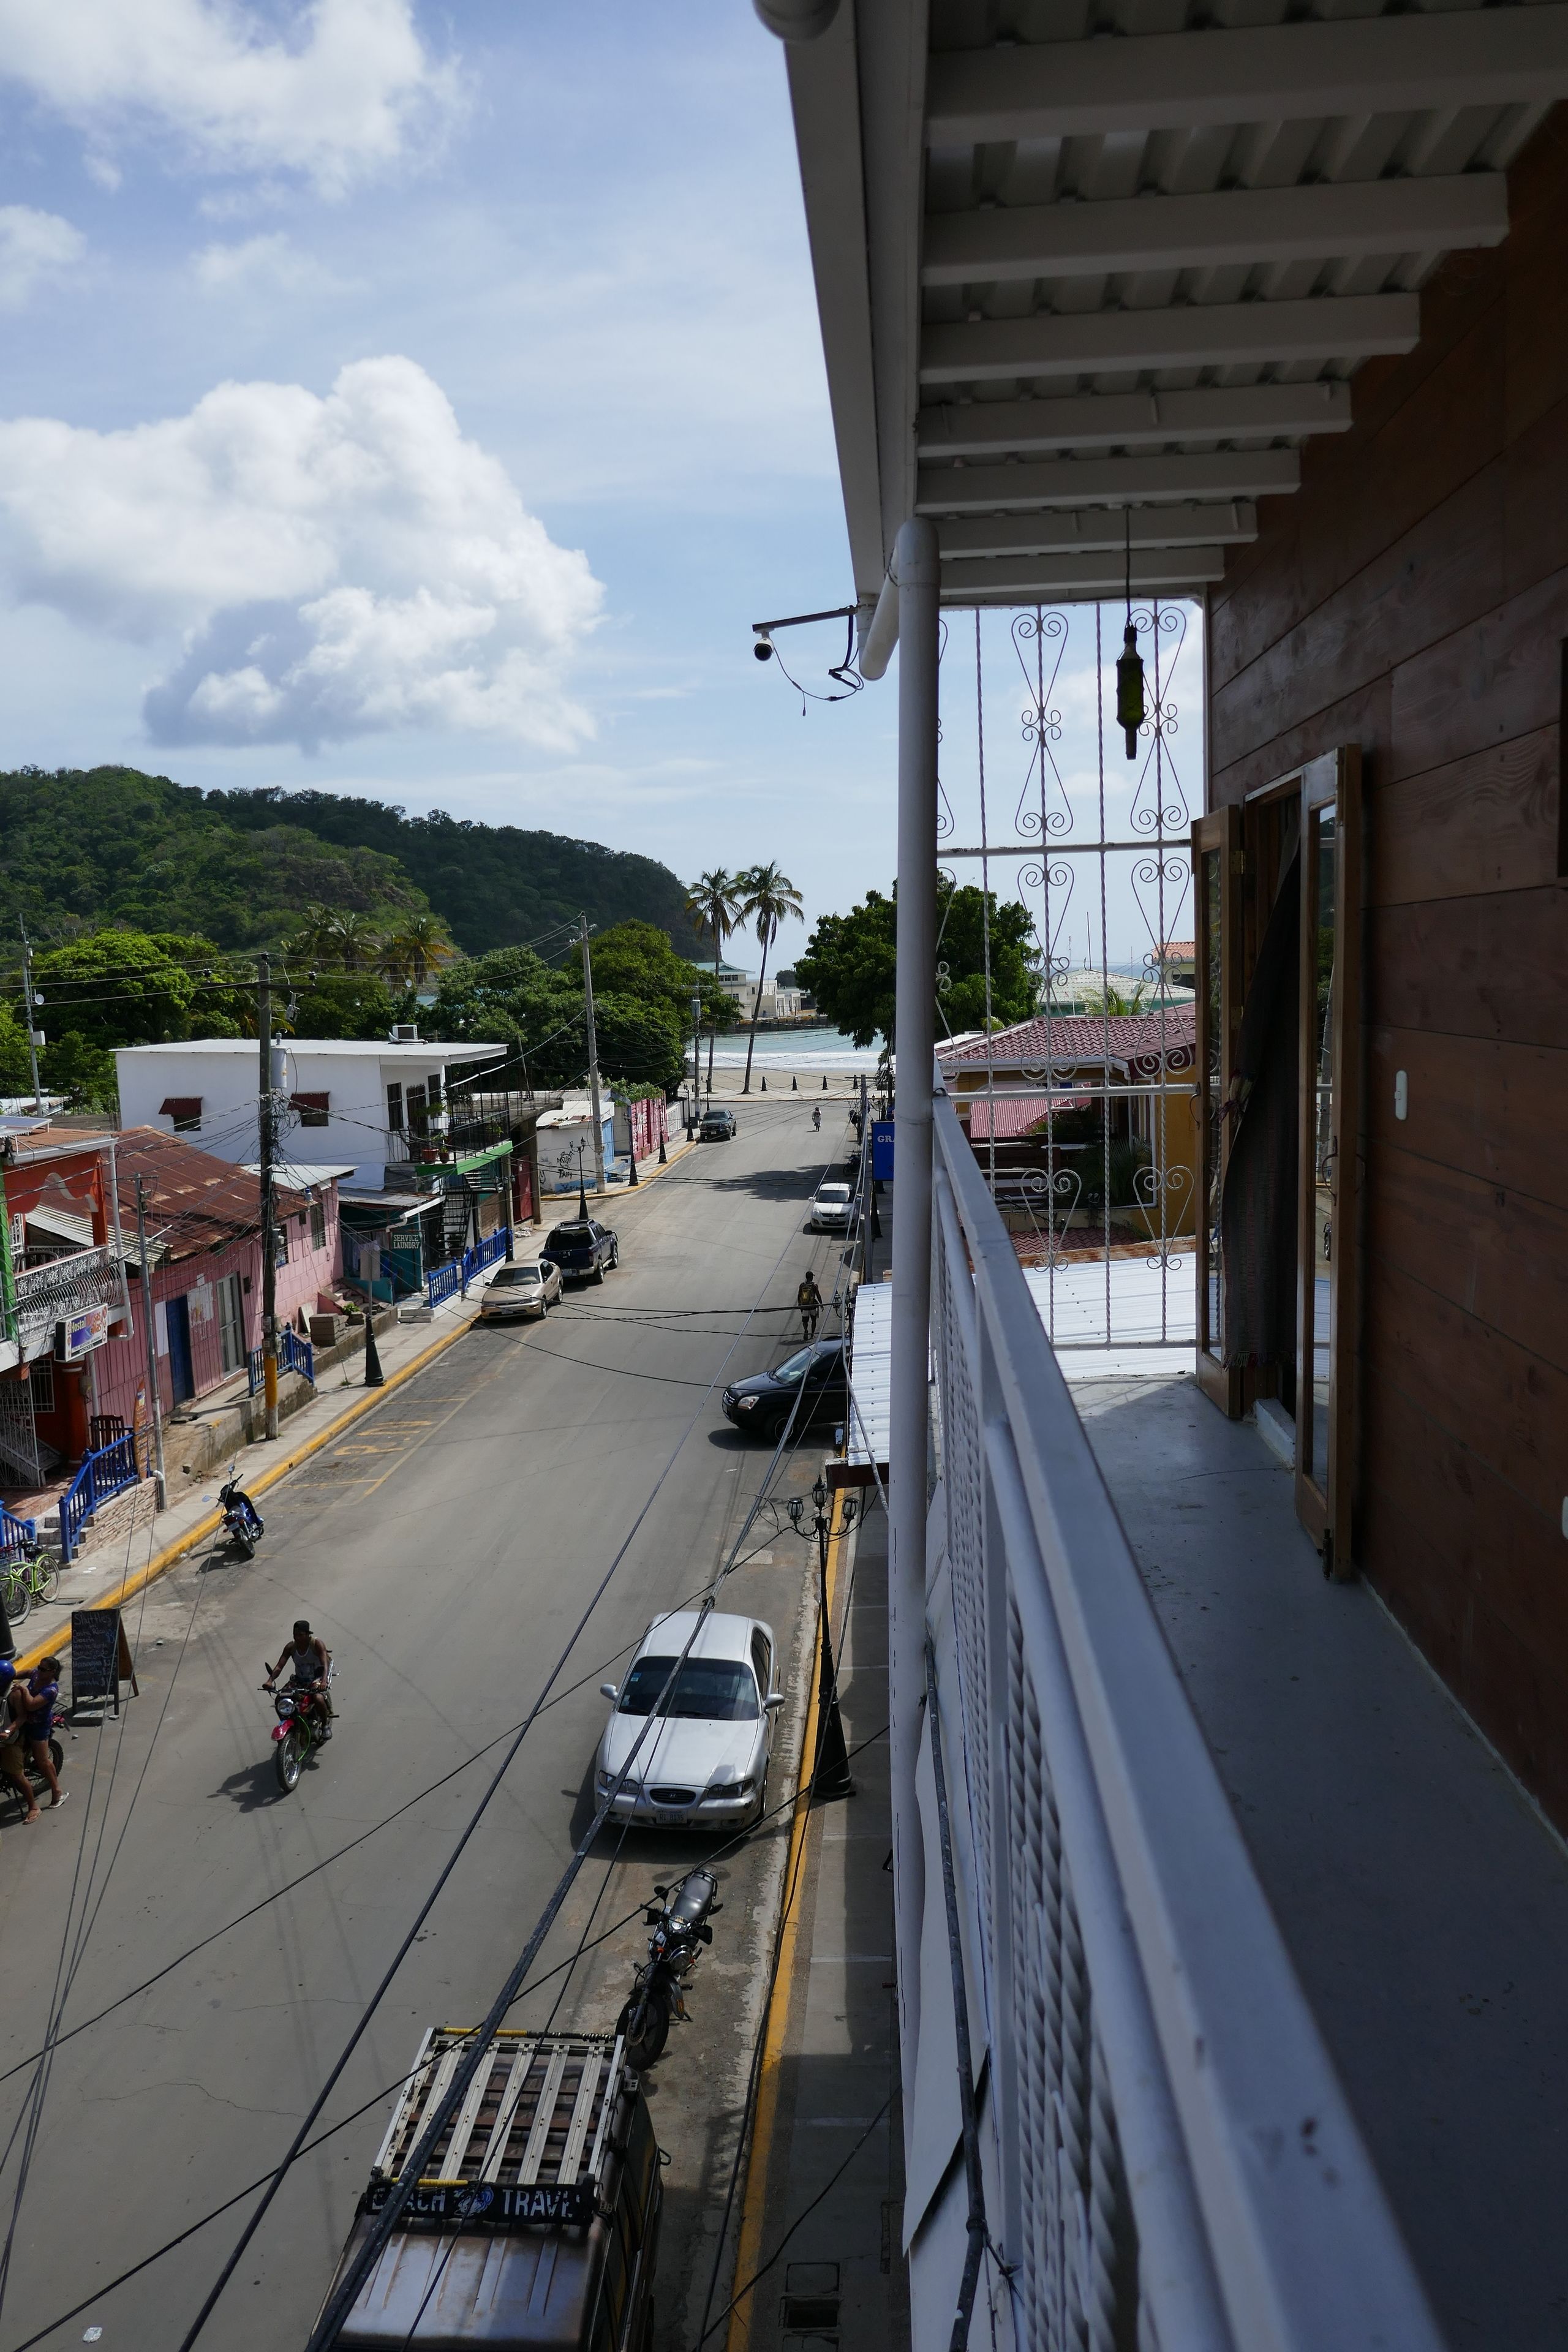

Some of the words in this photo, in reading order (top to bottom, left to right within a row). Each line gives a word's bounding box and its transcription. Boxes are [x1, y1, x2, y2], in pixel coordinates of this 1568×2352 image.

[71, 1316, 86, 1333] Hostal
[74, 1612, 111, 1625] Shuttles
[372, 2187, 447, 2212] ACH
[502, 2188, 581, 2218] TRAVE
